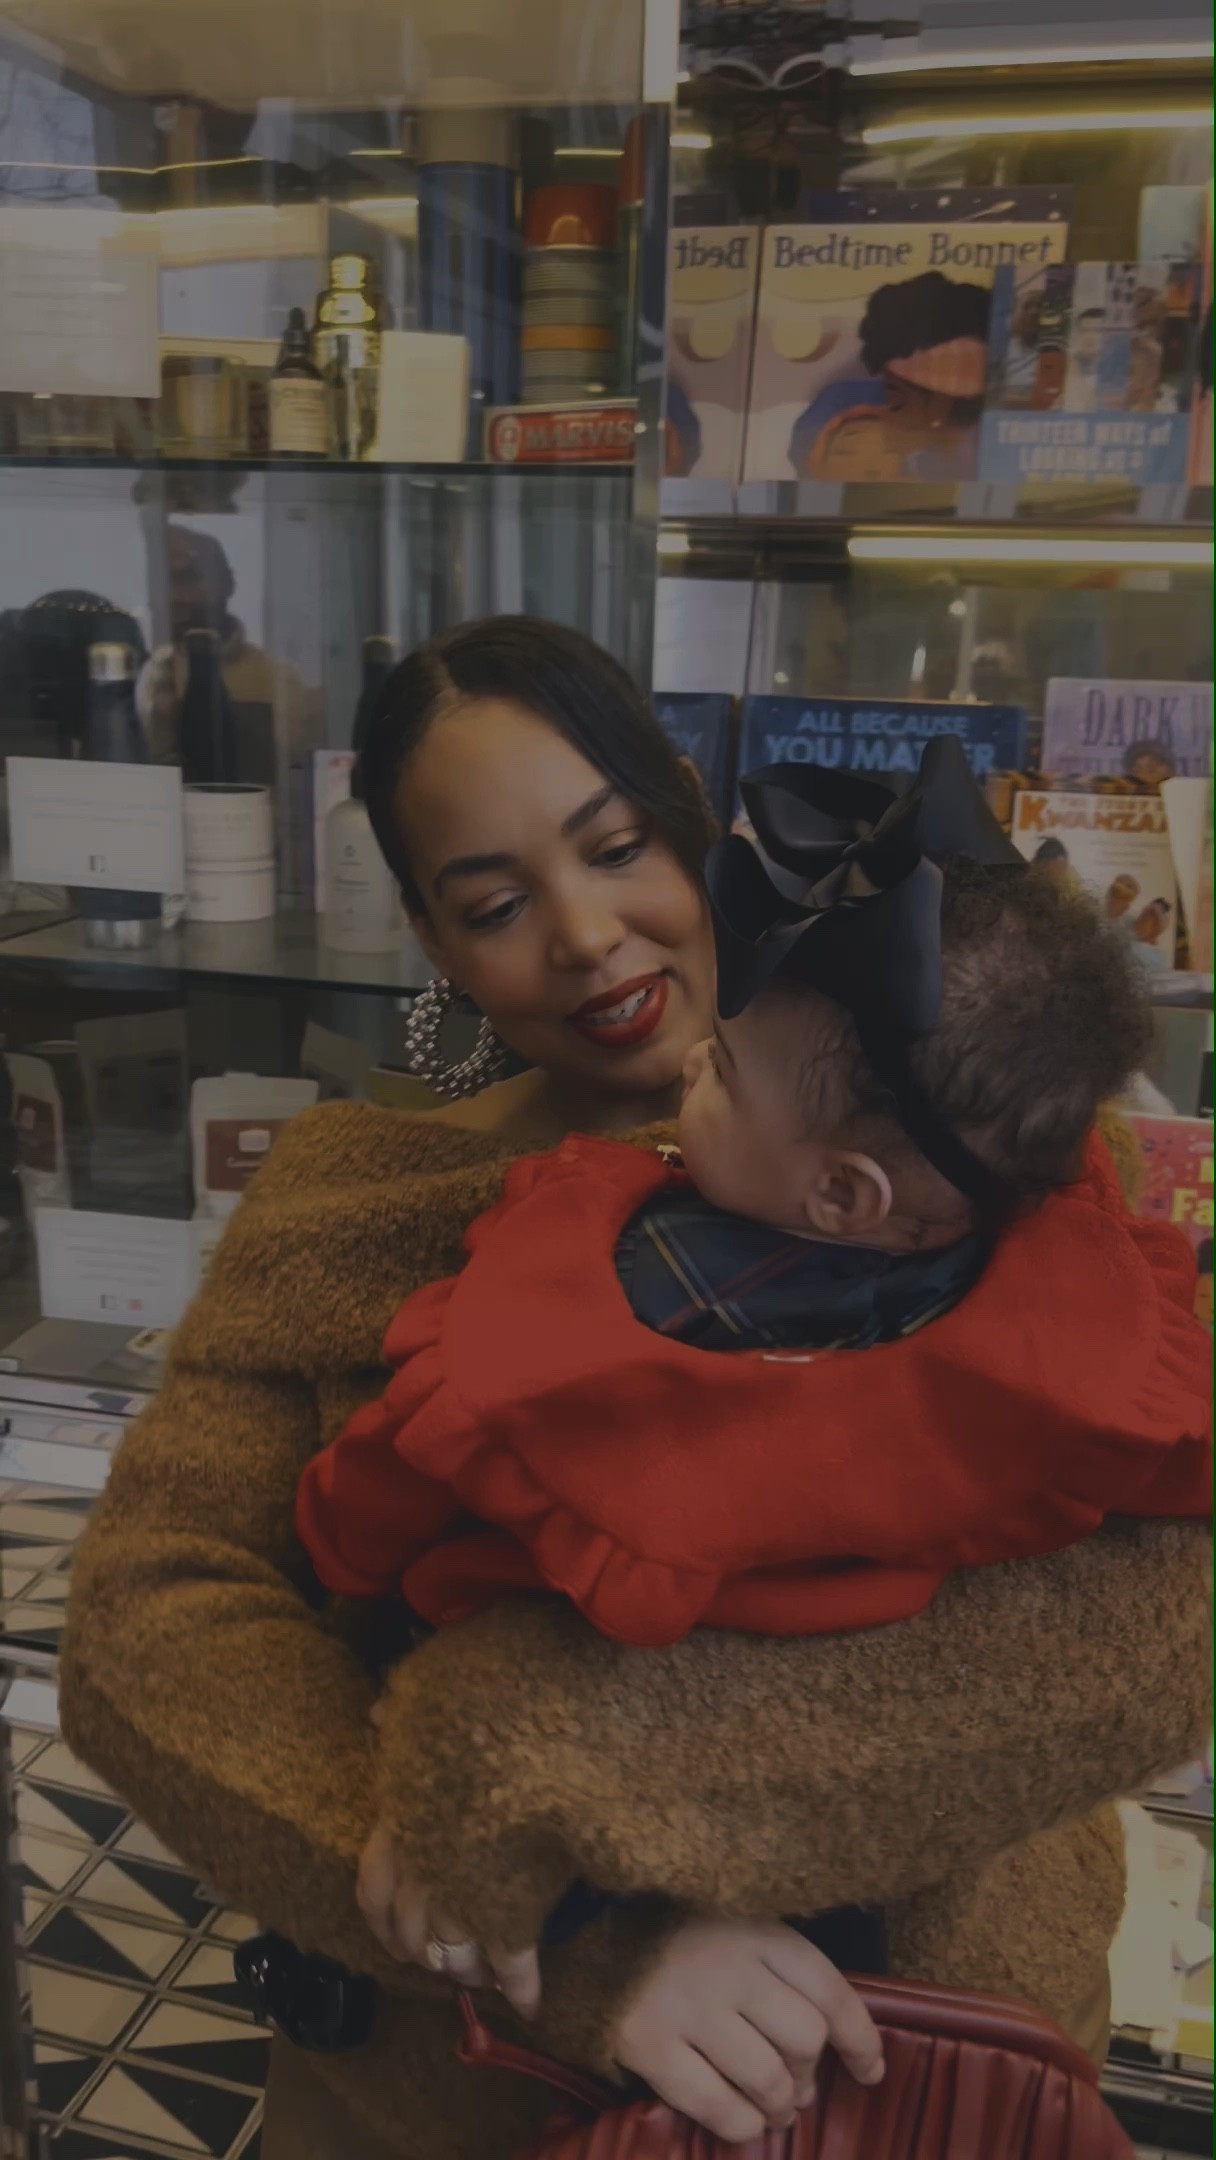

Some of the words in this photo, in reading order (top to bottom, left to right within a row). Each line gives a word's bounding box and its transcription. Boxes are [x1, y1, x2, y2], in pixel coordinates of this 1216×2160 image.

[774, 232, 913, 270] Bedtime
[928, 230, 1055, 269] Bonnet
[525, 418, 635, 450] MARVIS
[796, 710, 844, 733] ALL
[851, 713, 970, 737] BECAUSE
[1080, 687, 1179, 750] DARK
[764, 734, 844, 769] YOU
